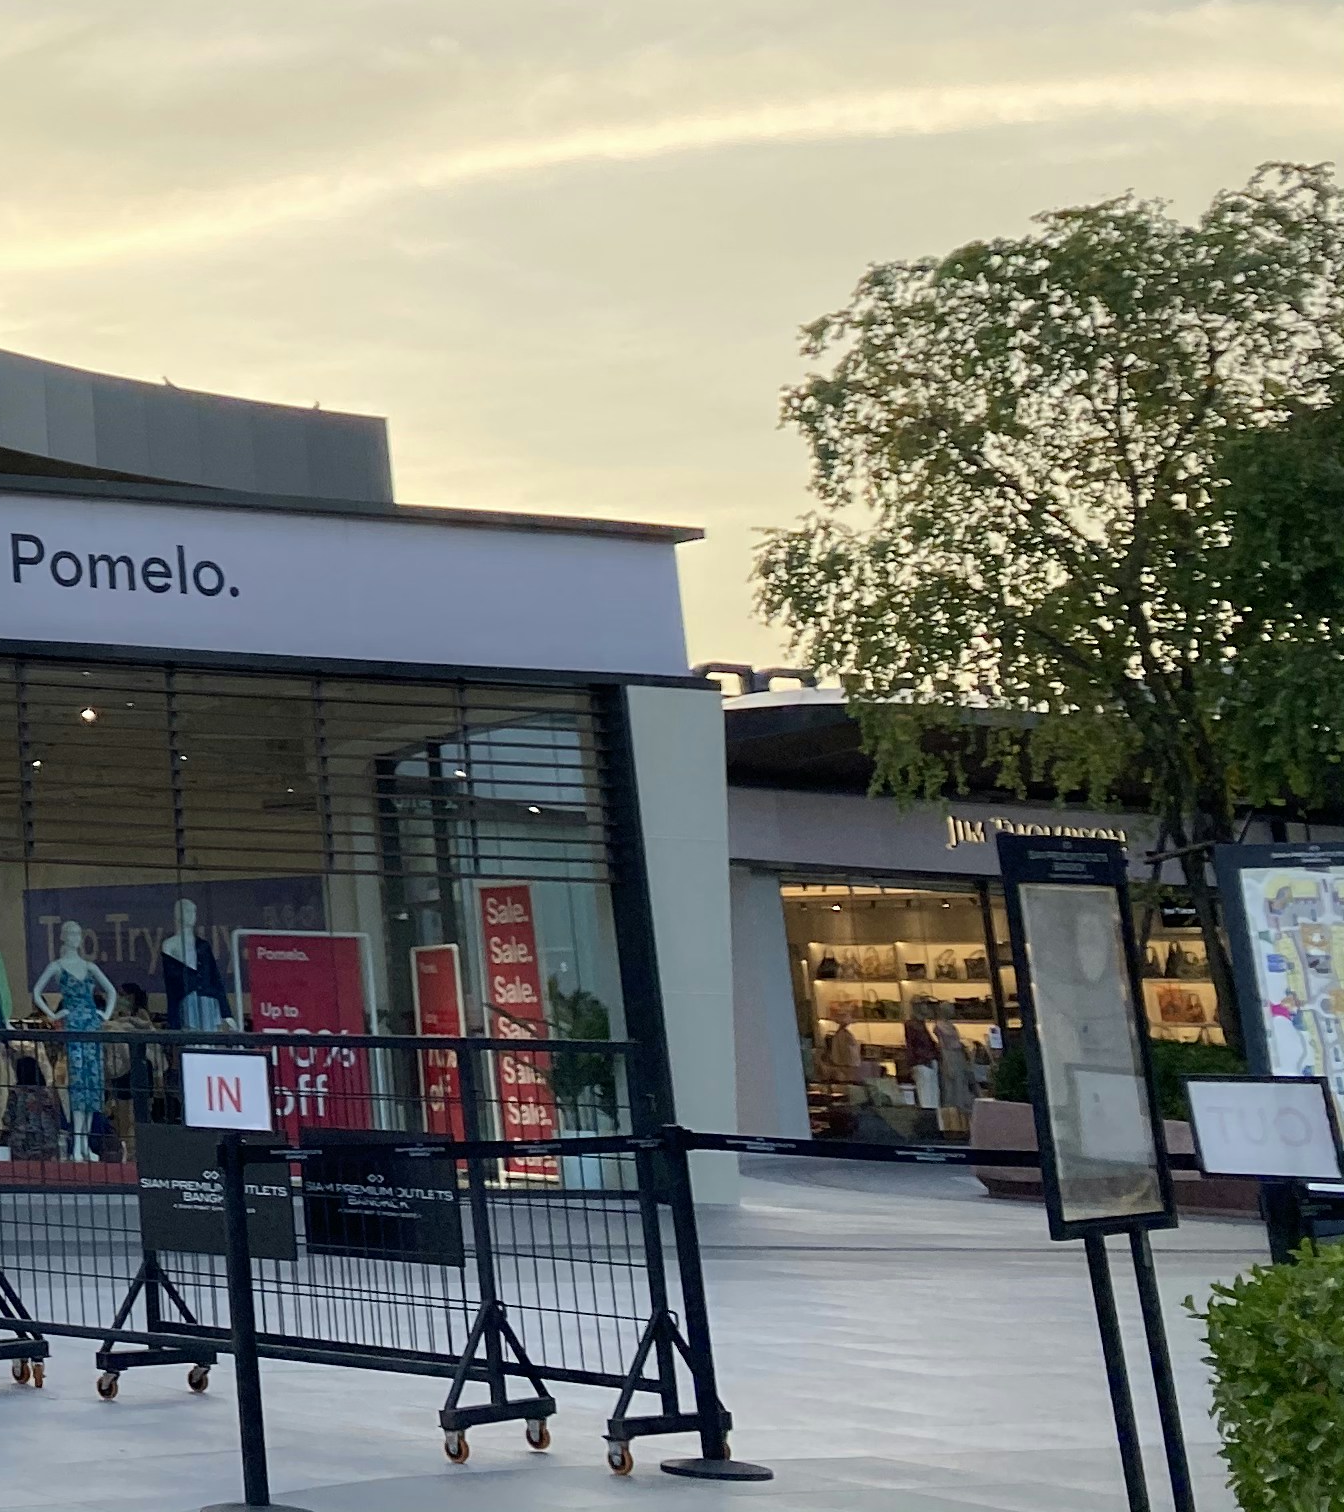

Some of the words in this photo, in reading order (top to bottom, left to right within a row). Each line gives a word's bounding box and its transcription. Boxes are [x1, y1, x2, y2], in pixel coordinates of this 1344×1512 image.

[10, 533, 239, 597] Pomelo.
[486, 897, 529, 924] Sale.
[490, 935, 533, 964] Sale.
[494, 975, 538, 1004] Sale.
[261, 1002, 282, 1020] Up
[284, 1004, 299, 1018] to
[207, 1076, 242, 1113] IN
[140, 1178, 169, 1189] SIAM
